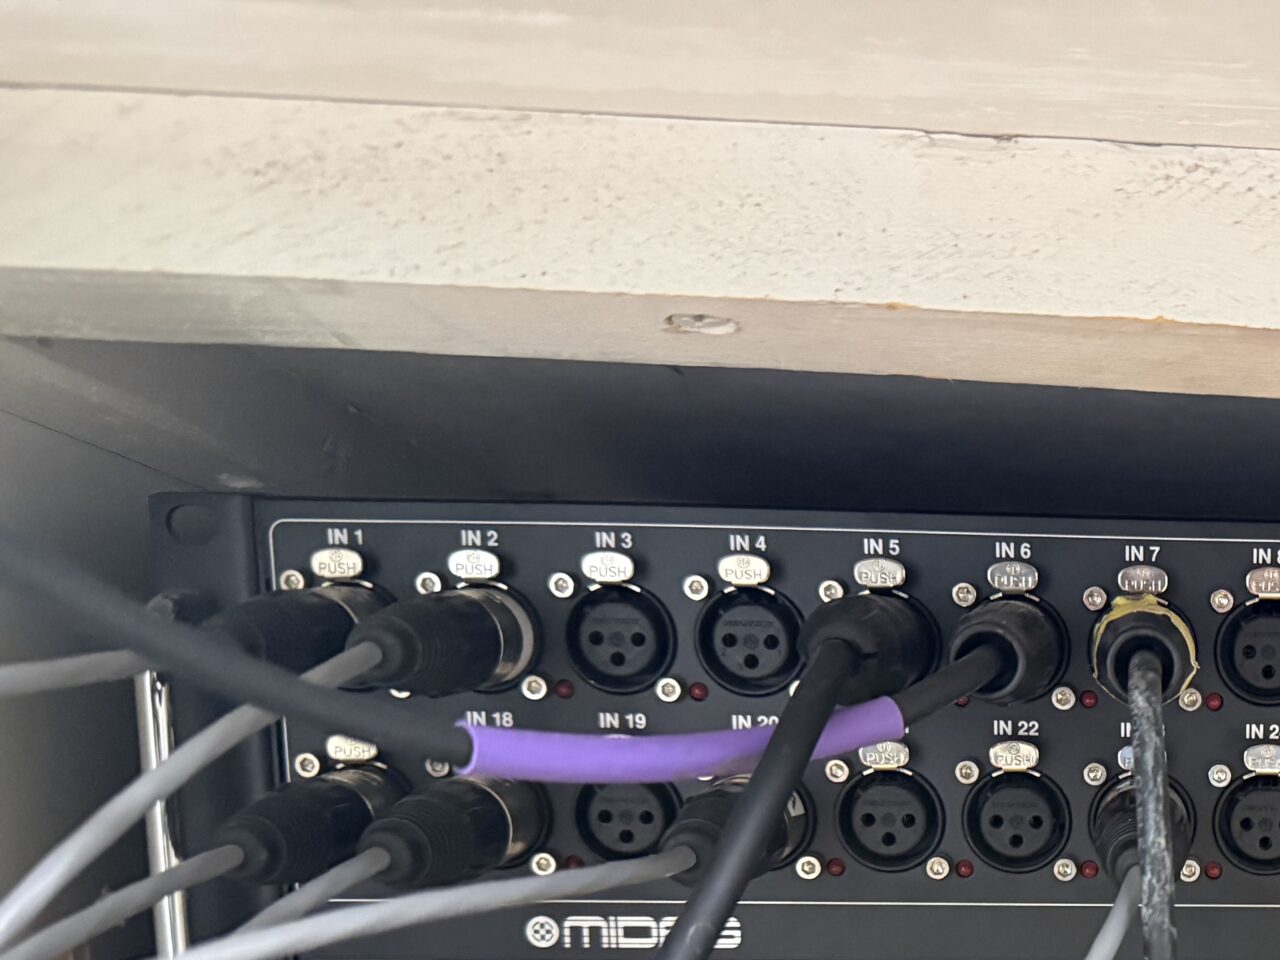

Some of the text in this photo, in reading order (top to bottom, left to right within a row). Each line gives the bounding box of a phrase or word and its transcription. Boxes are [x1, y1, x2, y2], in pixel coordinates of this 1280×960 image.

[327, 527, 363, 545] IN 1
[460, 529, 499, 547] IN 2
[594, 531, 633, 549] IN 3
[729, 534, 767, 552] IN 4
[863, 537, 900, 556] IN 5
[995, 541, 1032, 559] IN 6
[1125, 544, 1161, 562] IN 7
[1252, 547, 1272, 565] IN
[317, 561, 356, 575] PUSH
[454, 563, 493, 577] PUSH
[588, 564, 627, 578] PUSH
[725, 567, 761, 580] PUSH
[861, 571, 898, 585] PUSH
[466, 710, 514, 728] IN 18
[598, 712, 647, 730] IN 19
[731, 715, 751, 729] IN
[993, 719, 1040, 736] IN 22
[1245, 723, 1264, 740] IN
[334, 744, 372, 758] PUSH
[866, 752, 903, 765] PUSH
